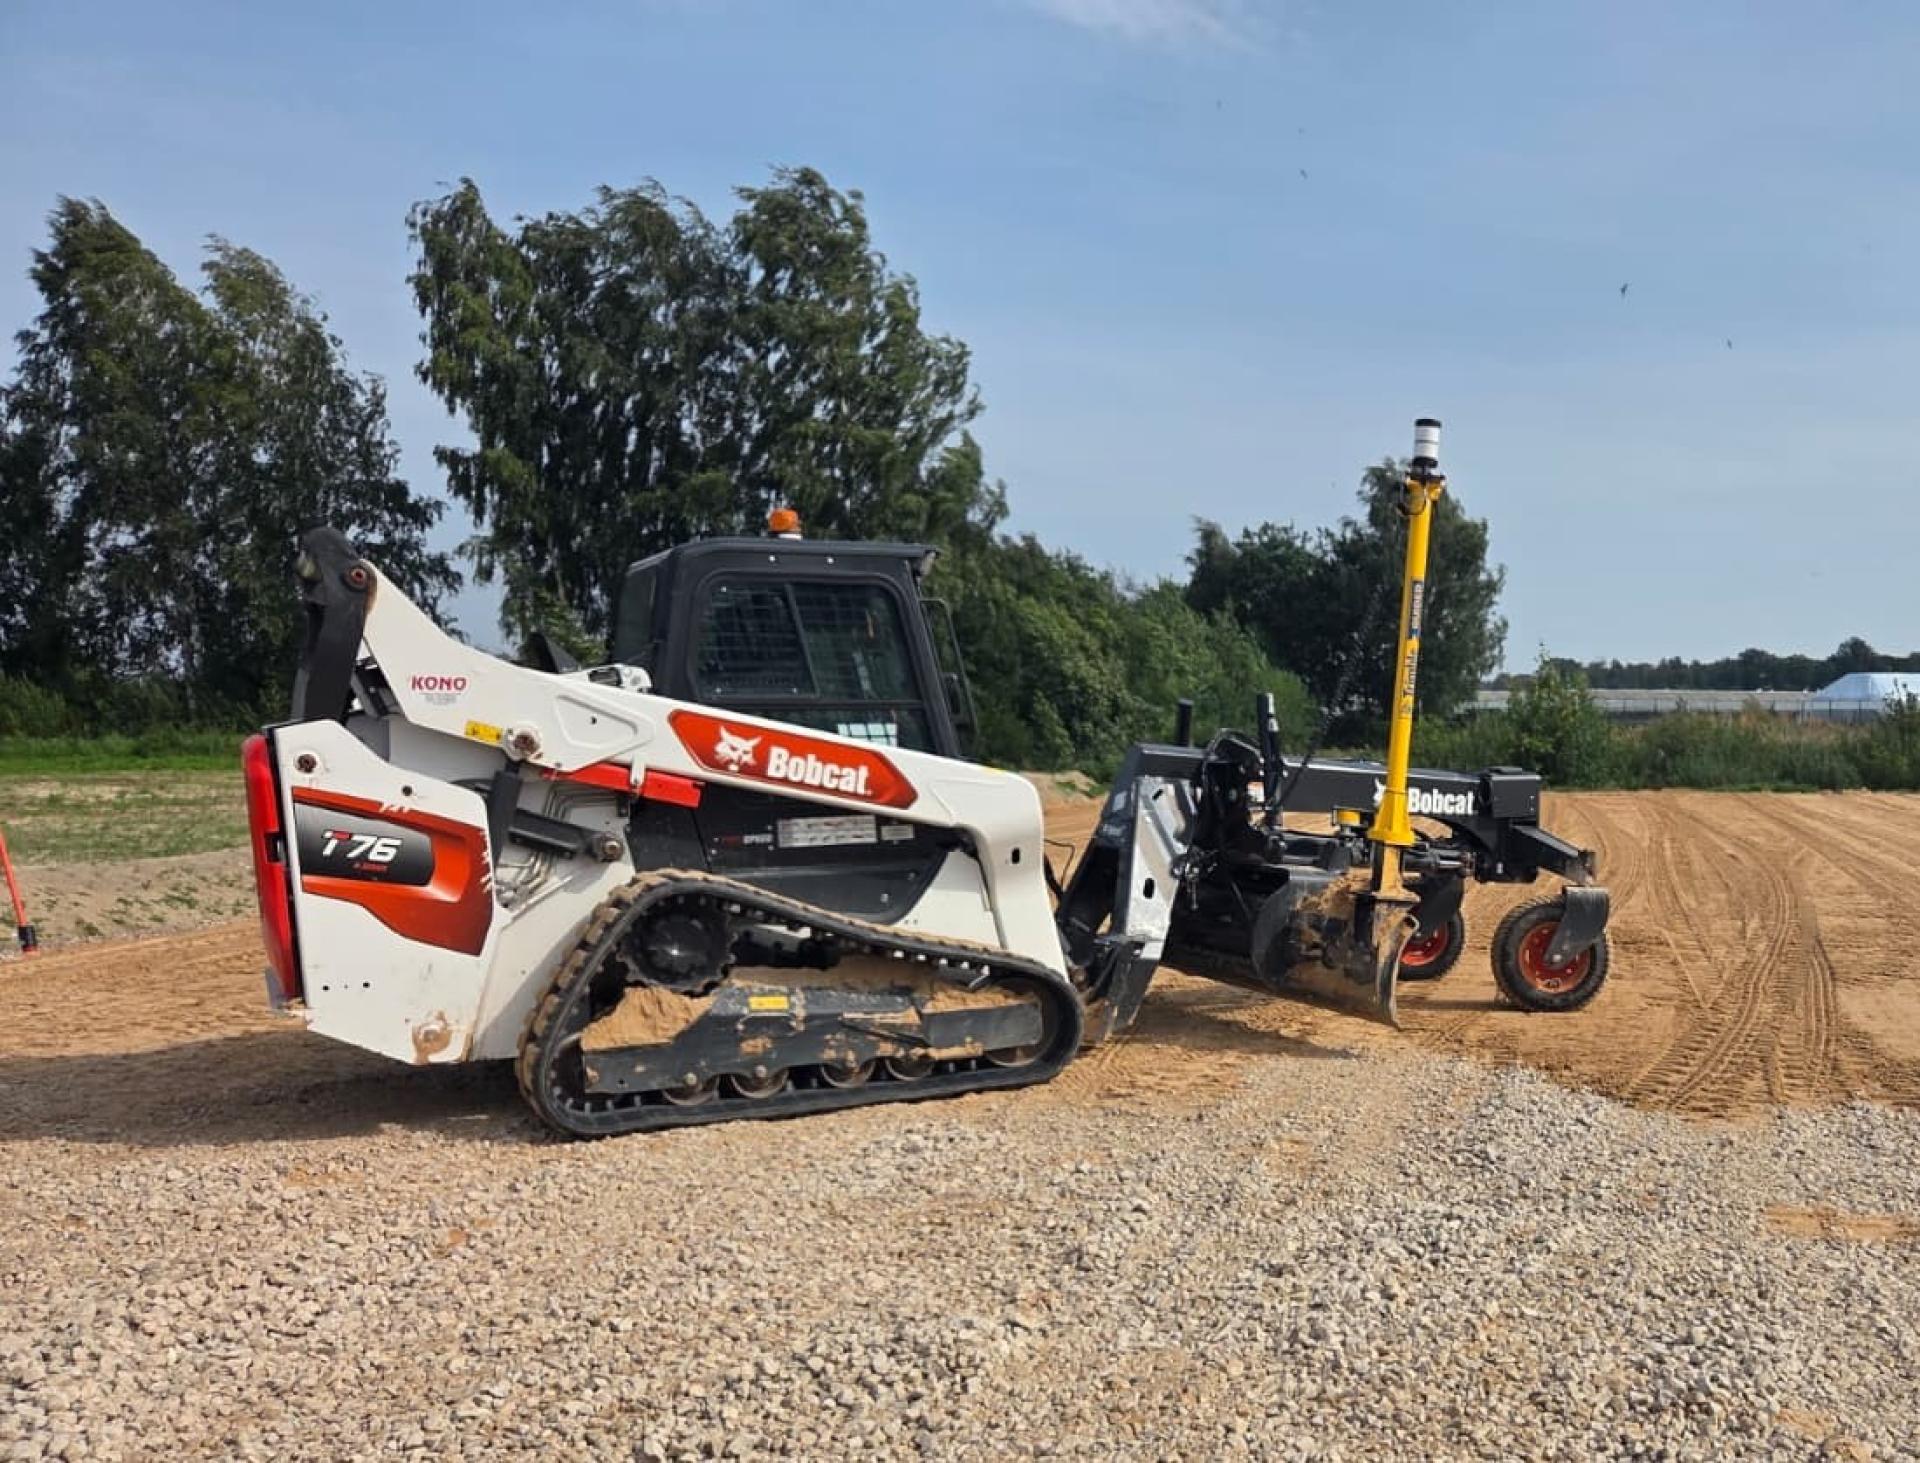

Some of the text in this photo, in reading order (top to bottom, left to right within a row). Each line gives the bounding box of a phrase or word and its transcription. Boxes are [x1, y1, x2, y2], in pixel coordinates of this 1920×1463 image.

[411, 675, 467, 691] KONO
[767, 745, 871, 795] Bobcat
[1408, 787, 1475, 815] Bobcat
[322, 830, 402, 862] T76
